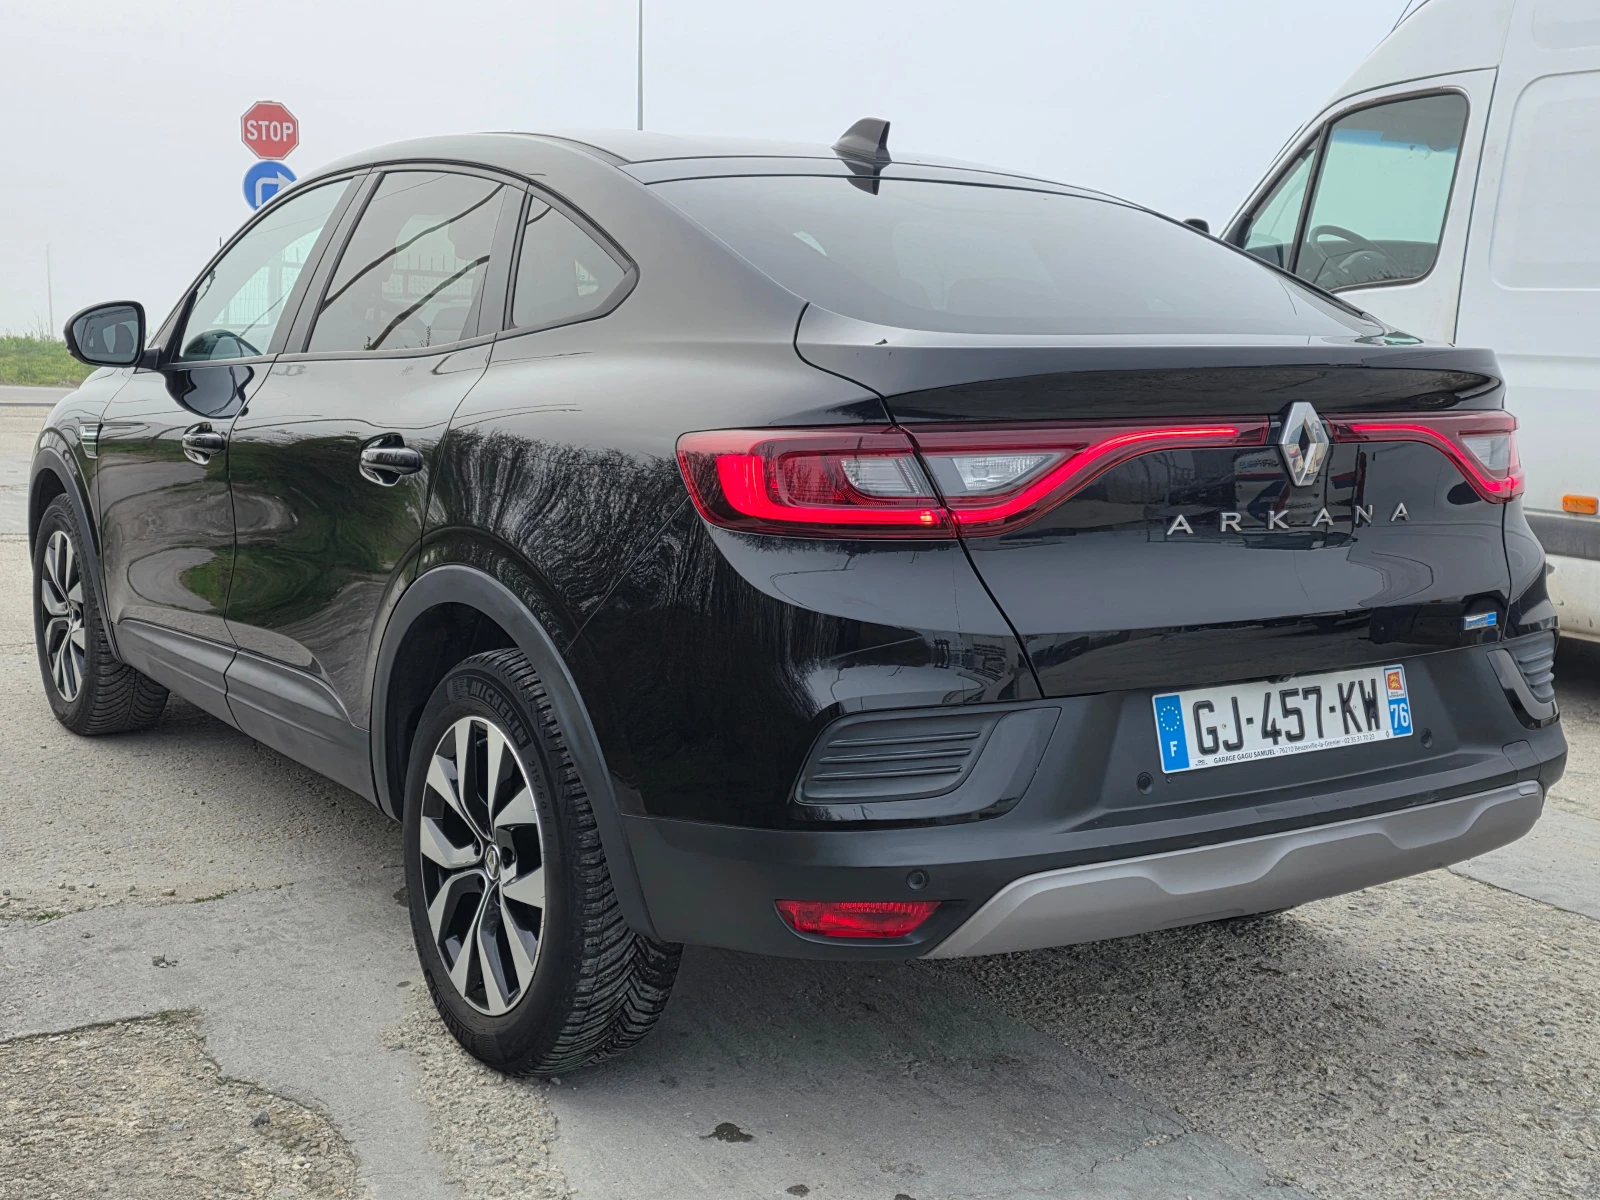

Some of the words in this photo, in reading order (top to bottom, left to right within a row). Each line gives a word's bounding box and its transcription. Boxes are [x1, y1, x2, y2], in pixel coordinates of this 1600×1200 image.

[246, 120, 294, 142] STOP
[1166, 502, 1410, 536] ARKANA
[470, 681, 527, 747] MICHELIN
[1192, 678, 1381, 756] GJ-457-KW
[1389, 702, 1410, 729] 76
[1170, 740, 1178, 757] F
[1213, 754, 1237, 764] GARAGE
[1237, 751, 1253, 761] GAGU
[1253, 748, 1276, 758] SAMUEL
[527, 760, 548, 811] 215/60
